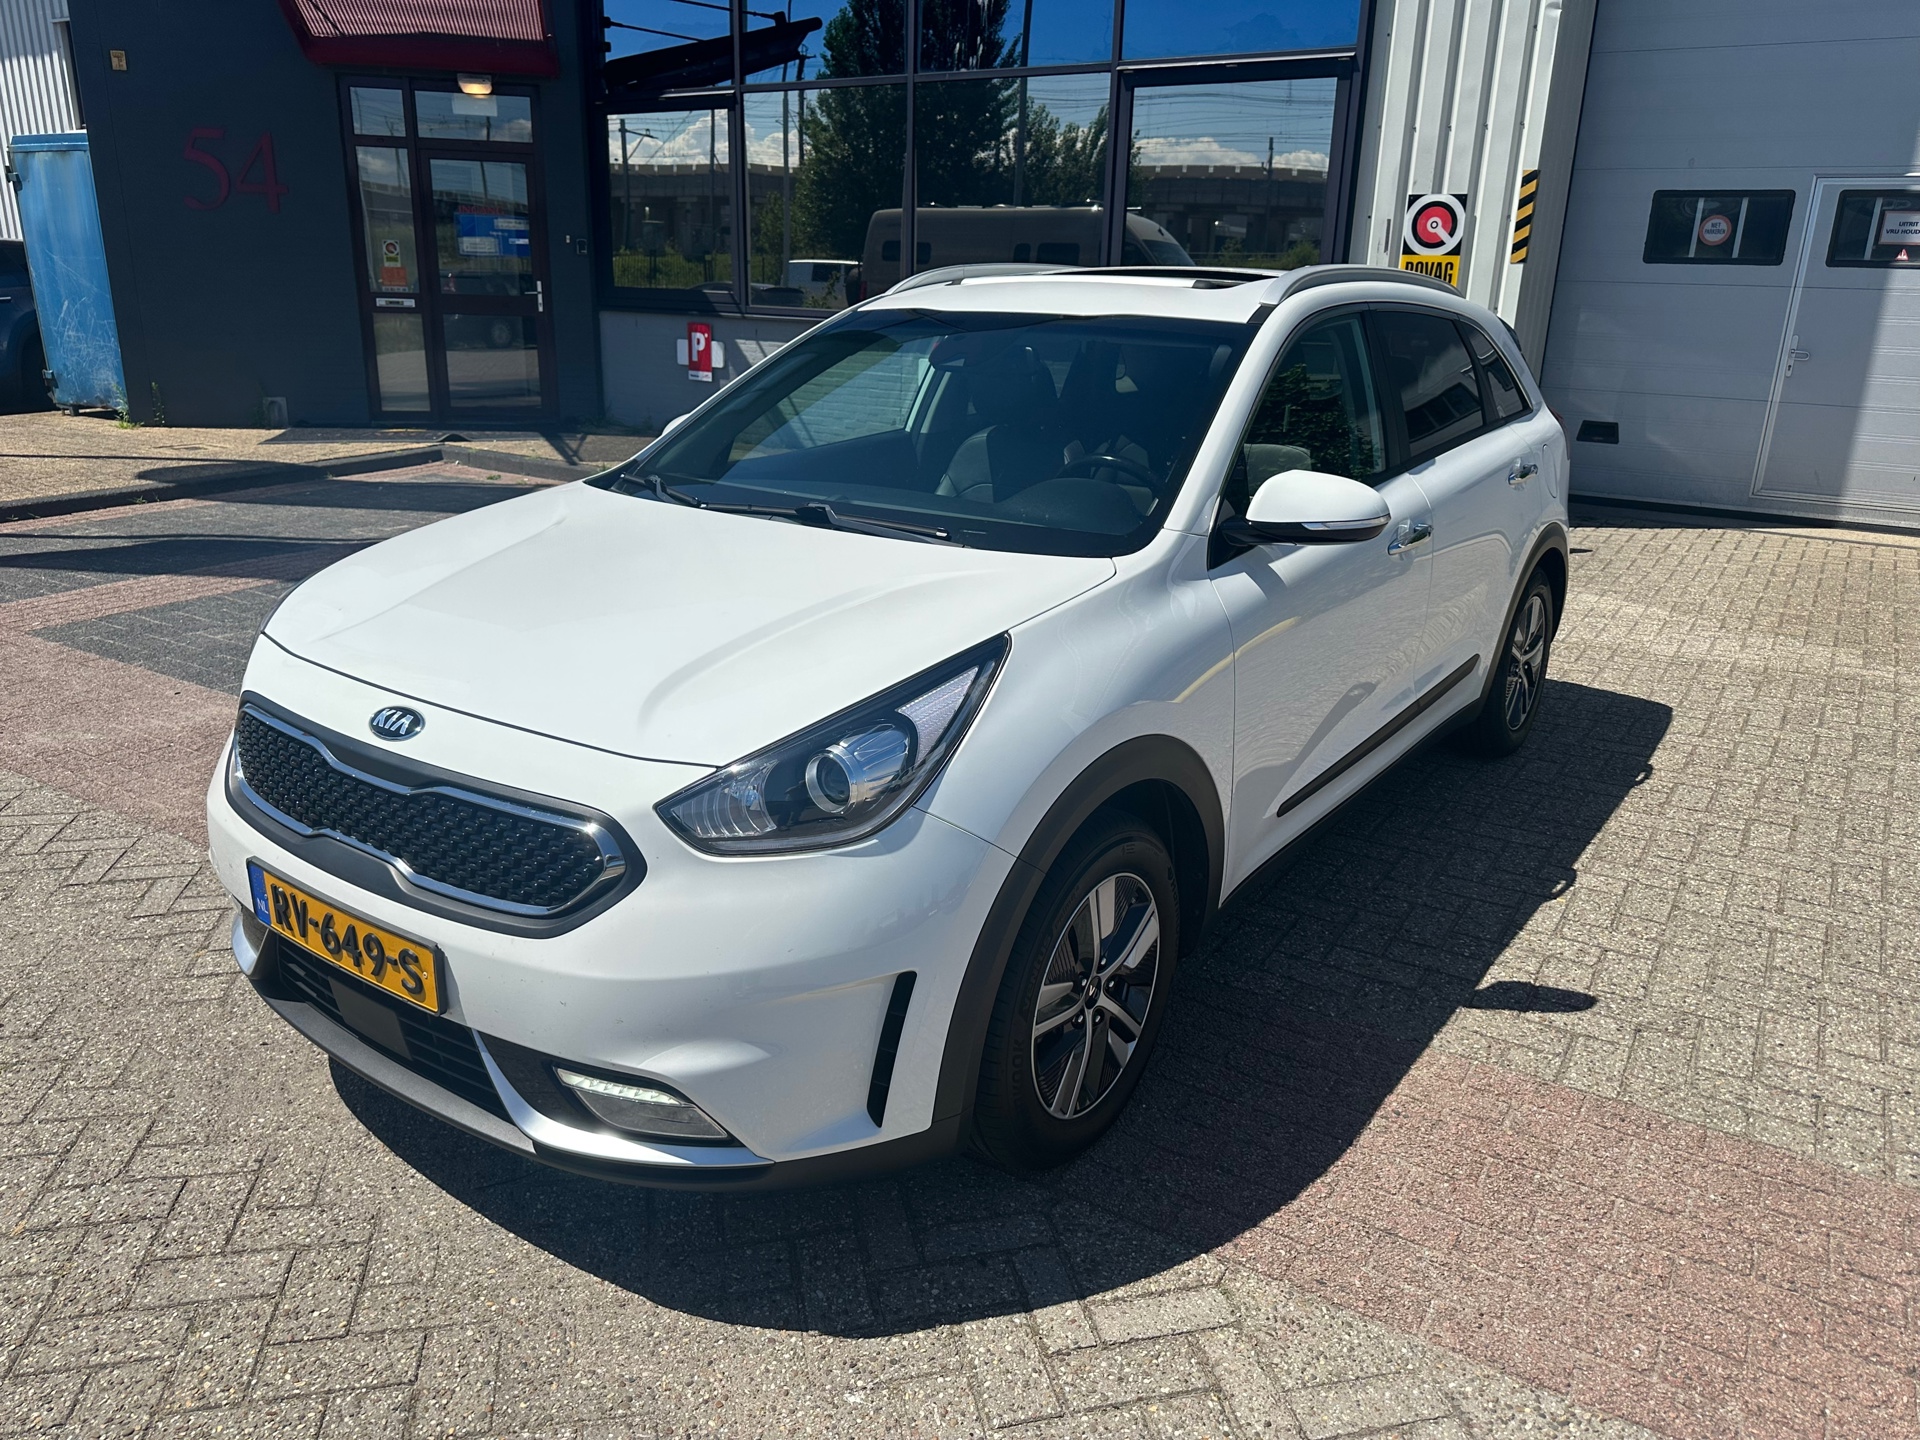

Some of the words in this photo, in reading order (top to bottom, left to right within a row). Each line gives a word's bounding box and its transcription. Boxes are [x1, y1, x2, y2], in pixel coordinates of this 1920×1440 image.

[183, 127, 289, 213] 54
[372, 708, 414, 735] KIA
[257, 899, 269, 915] NL
[270, 883, 424, 995] RV-649-S
